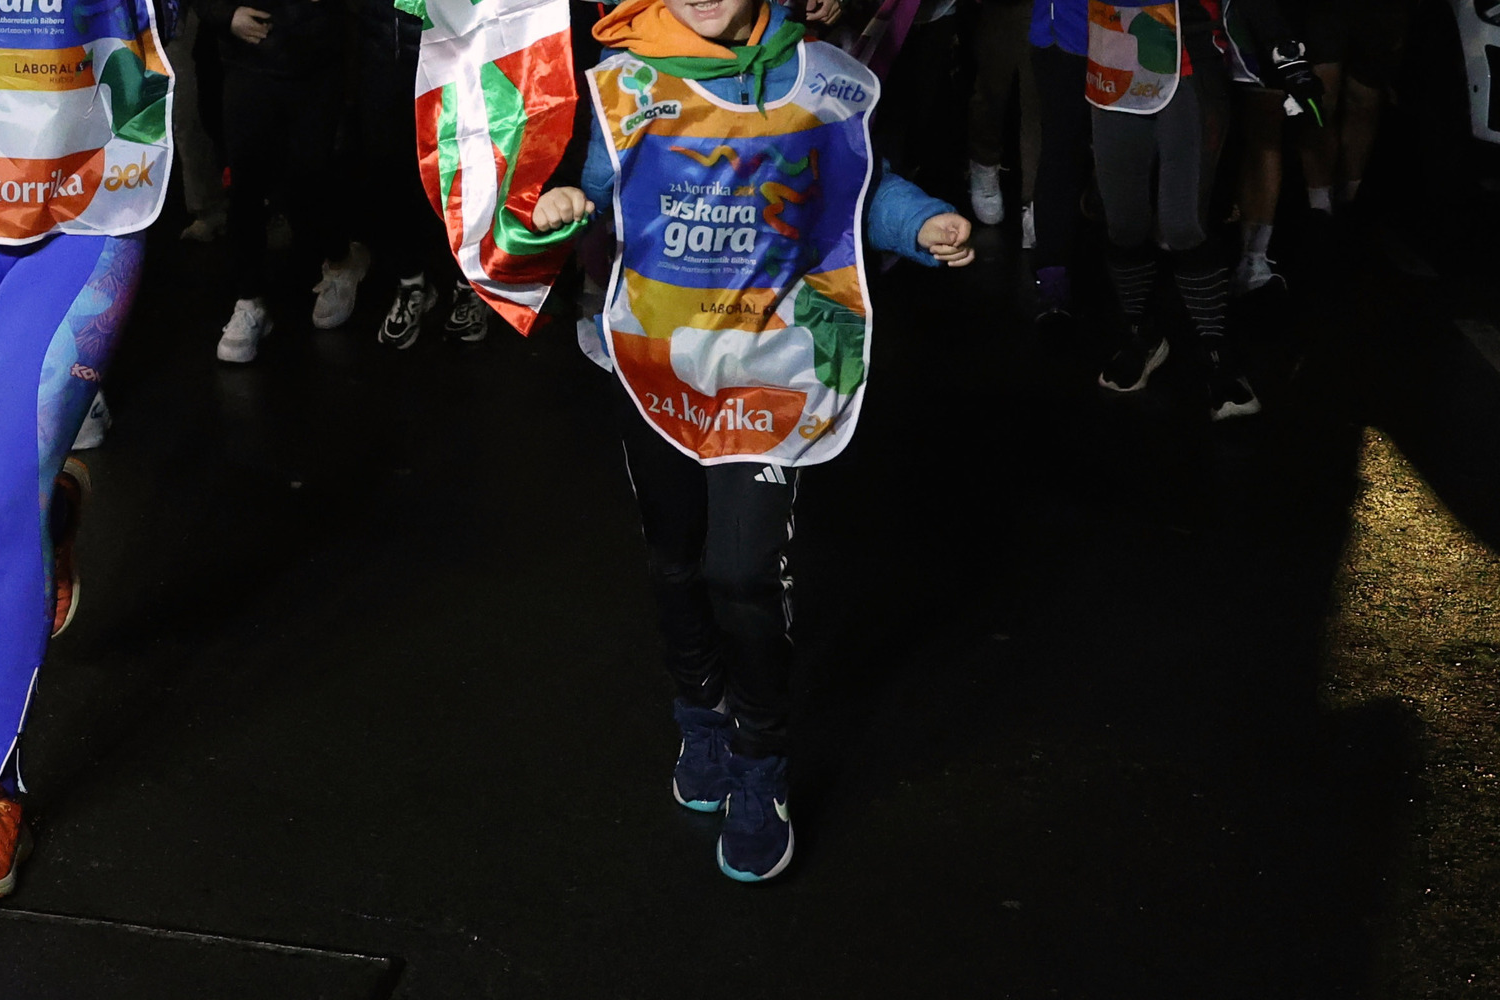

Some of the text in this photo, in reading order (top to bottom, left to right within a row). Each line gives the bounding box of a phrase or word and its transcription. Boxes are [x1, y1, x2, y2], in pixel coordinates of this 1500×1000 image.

[14, 62, 75, 75] LABORAL
[828, 79, 866, 103] eitb
[104, 151, 155, 192] aek
[660, 195, 756, 224] Euskara
[663, 222, 757, 258] gara
[700, 302, 761, 315] LABORAL
